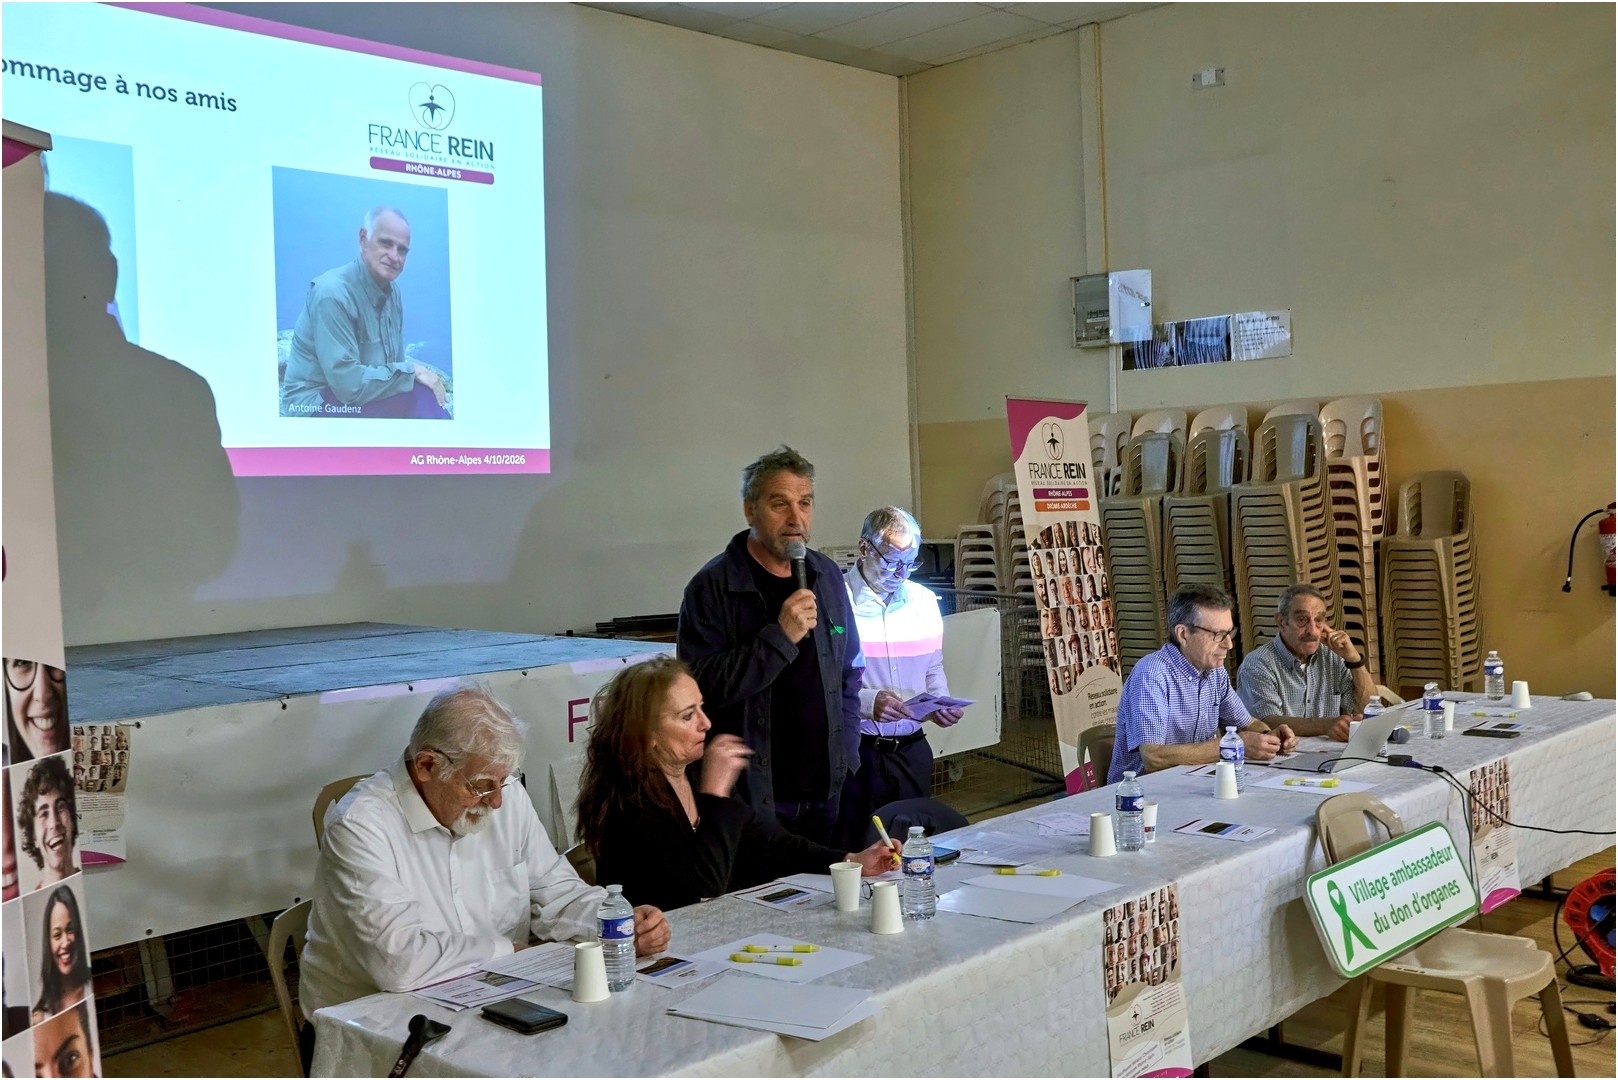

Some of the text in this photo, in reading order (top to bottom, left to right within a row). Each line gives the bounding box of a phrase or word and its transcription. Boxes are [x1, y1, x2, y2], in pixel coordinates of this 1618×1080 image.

[115, 74, 129, 95] à
[136, 81, 178, 102] nos
[185, 91, 237, 112] amis
[368, 123, 494, 162] FRANCE REIN
[405, 162, 462, 179] RHÔNE-ALPES
[288, 403, 362, 414] Antoine Gaudenz
[410, 454, 526, 467] AG Rhône-Alpes 4/10/2026
[1028, 462, 1086, 479] FRANCE REIN
[1348, 875, 1390, 904] Village
[1389, 845, 1454, 888] ambassadeur
[1373, 911, 1391, 934] du
[1389, 904, 1413, 926] don
[1411, 879, 1461, 914] d'organes
[1140, 1019, 1155, 1033] REIN
